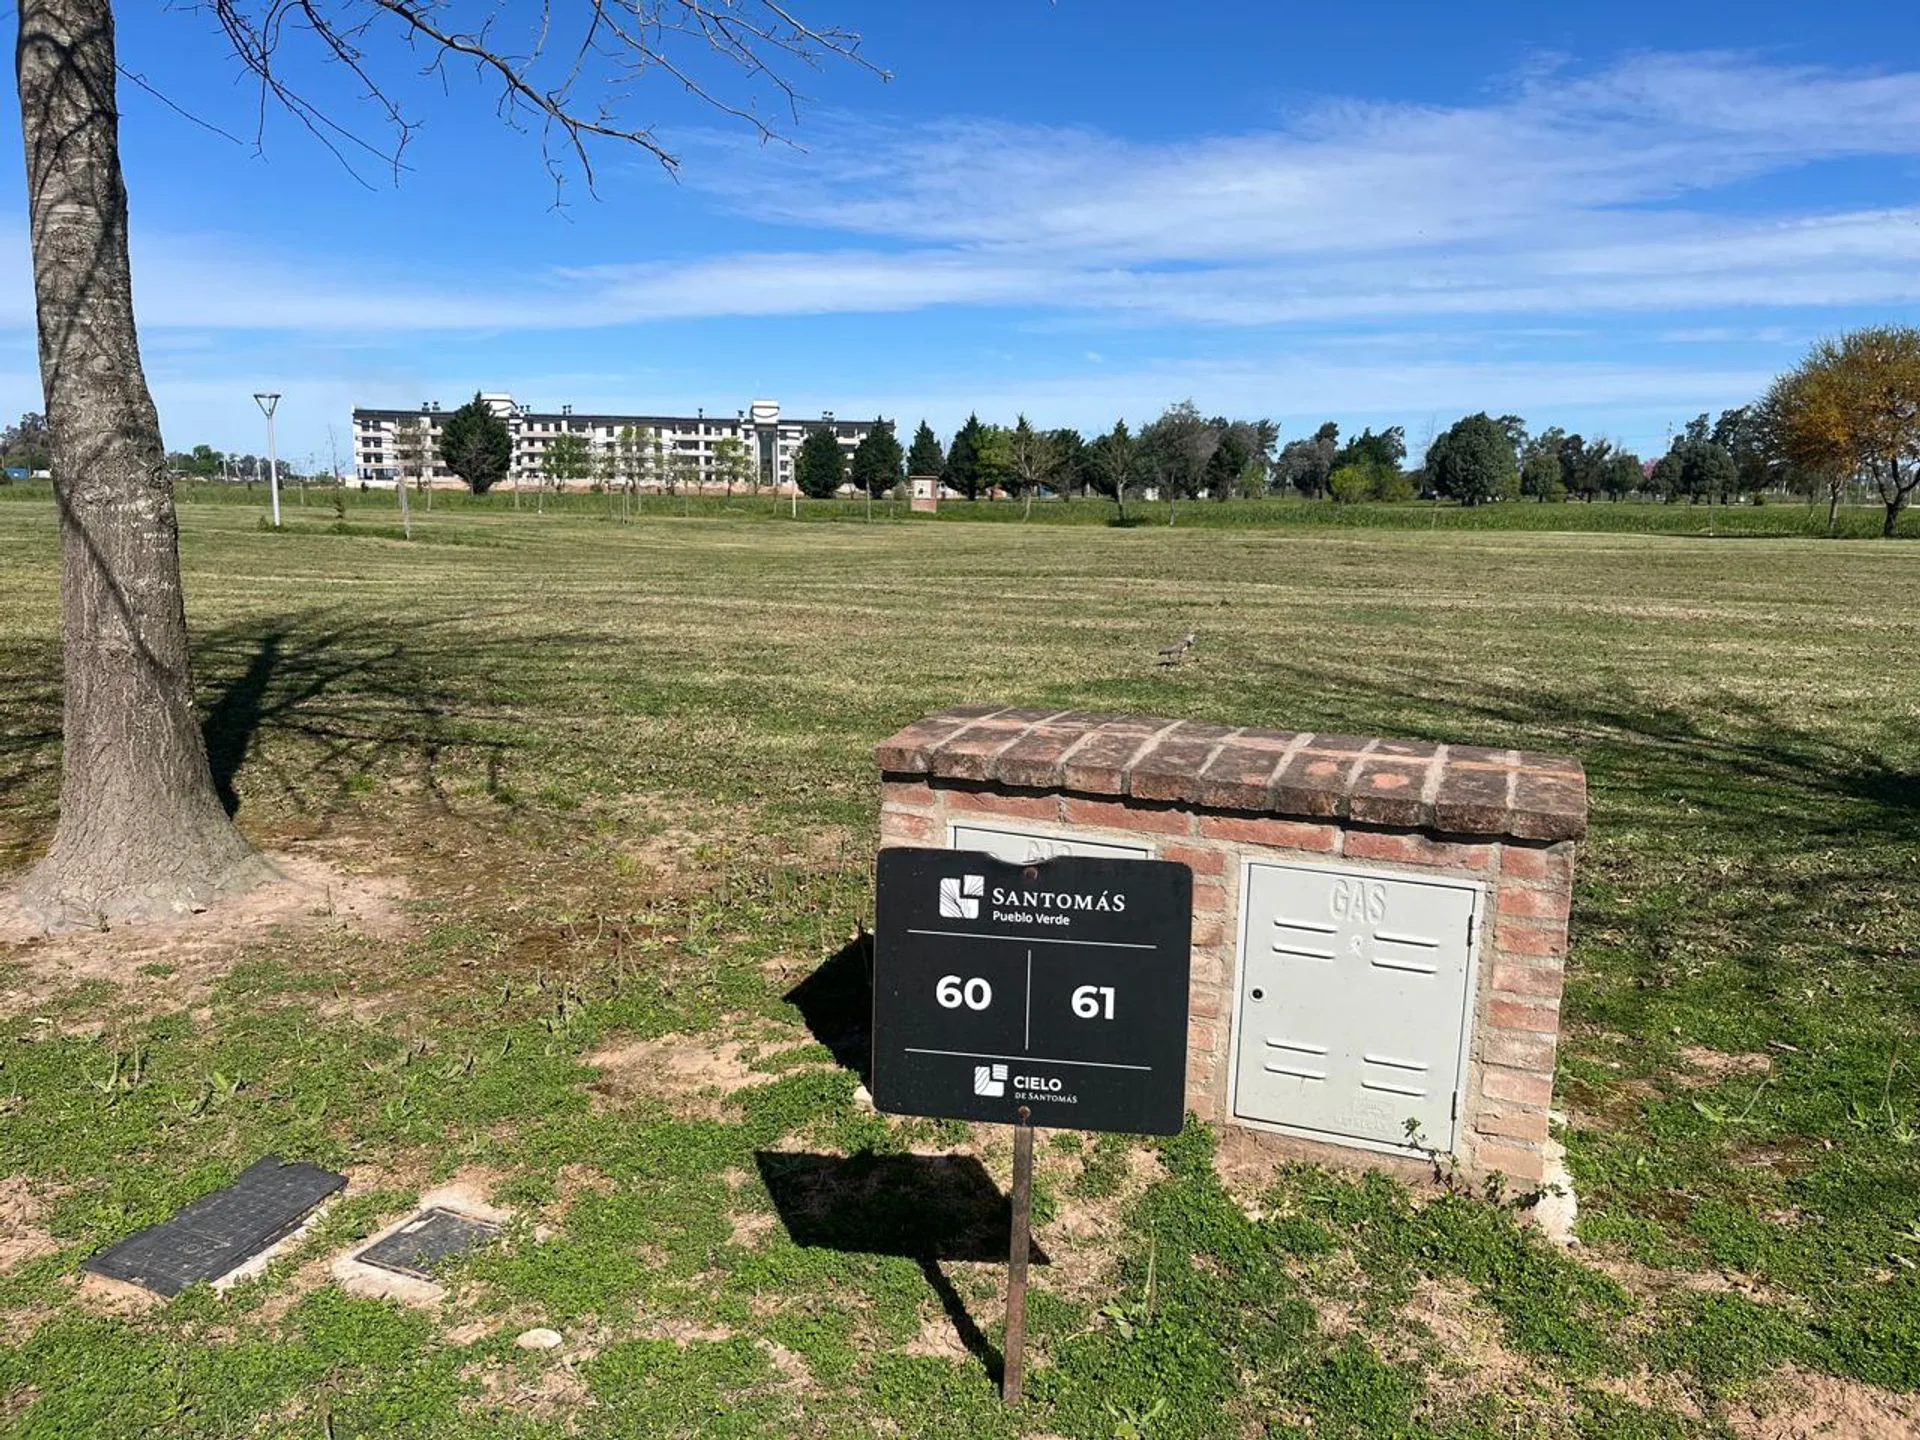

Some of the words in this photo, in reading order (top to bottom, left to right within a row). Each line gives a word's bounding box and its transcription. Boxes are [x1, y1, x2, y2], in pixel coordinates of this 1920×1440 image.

[992, 887, 1126, 912] SANTOMÁS
[1330, 879, 1386, 925] GAS
[992, 910, 1033, 923] Pueblo
[1035, 912, 1071, 925] Verde
[935, 974, 993, 1011] 60
[1070, 984, 1116, 1020] 61
[1013, 1075, 1062, 1092] CIELO
[1015, 1091, 1027, 1100] DE
[1028, 1091, 1078, 1104] SANTOMÁS
